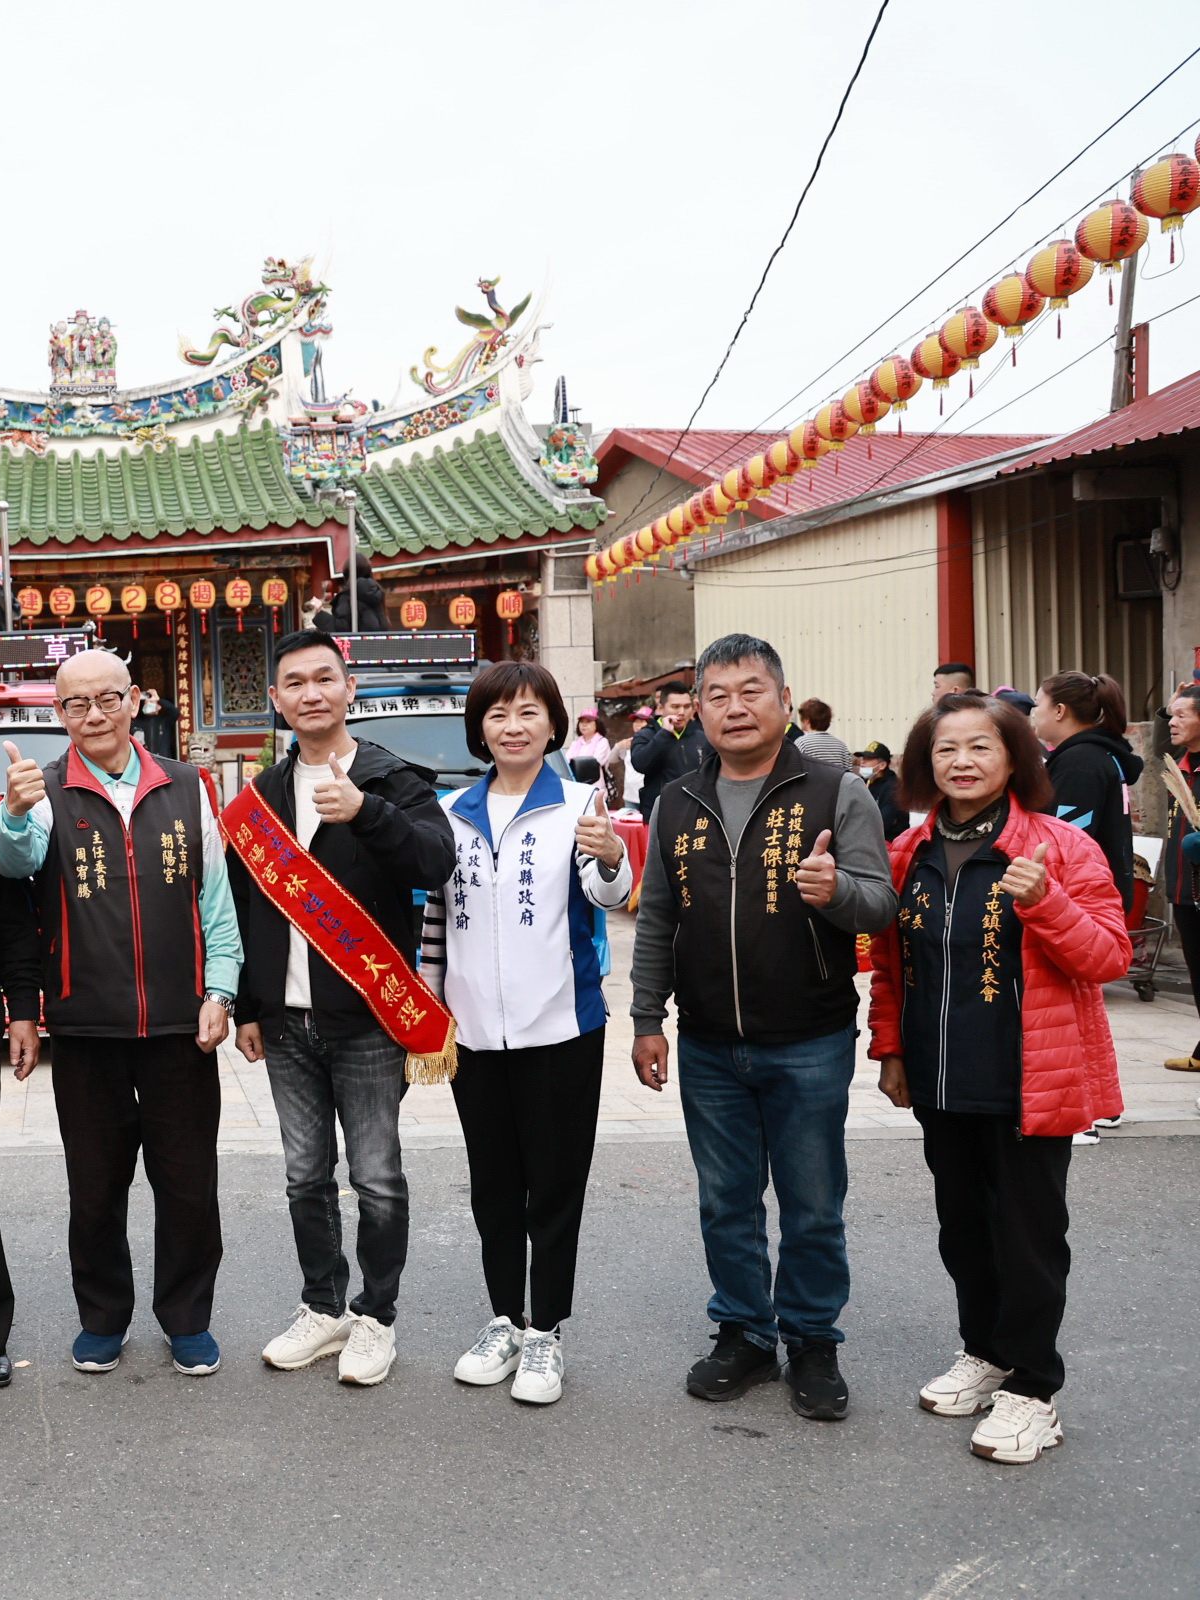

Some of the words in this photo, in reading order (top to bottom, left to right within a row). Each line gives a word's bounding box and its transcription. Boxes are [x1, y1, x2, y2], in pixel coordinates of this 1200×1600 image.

[91, 830, 108, 890] 主任委員
[160, 832, 177, 884] 朝陽宮
[173, 819, 189, 878] 縣定古蹟
[467, 836, 482, 888] 民政處
[692, 817, 709, 851] 助理
[760, 807, 786, 868] 莊士傑
[784, 802, 805, 884] 南投縣議員
[452, 869, 471, 931] 林琦瑜
[518, 831, 537, 927] 南投縣政府
[766, 868, 780, 914] 服務團隊
[910, 892, 931, 930] 代表
